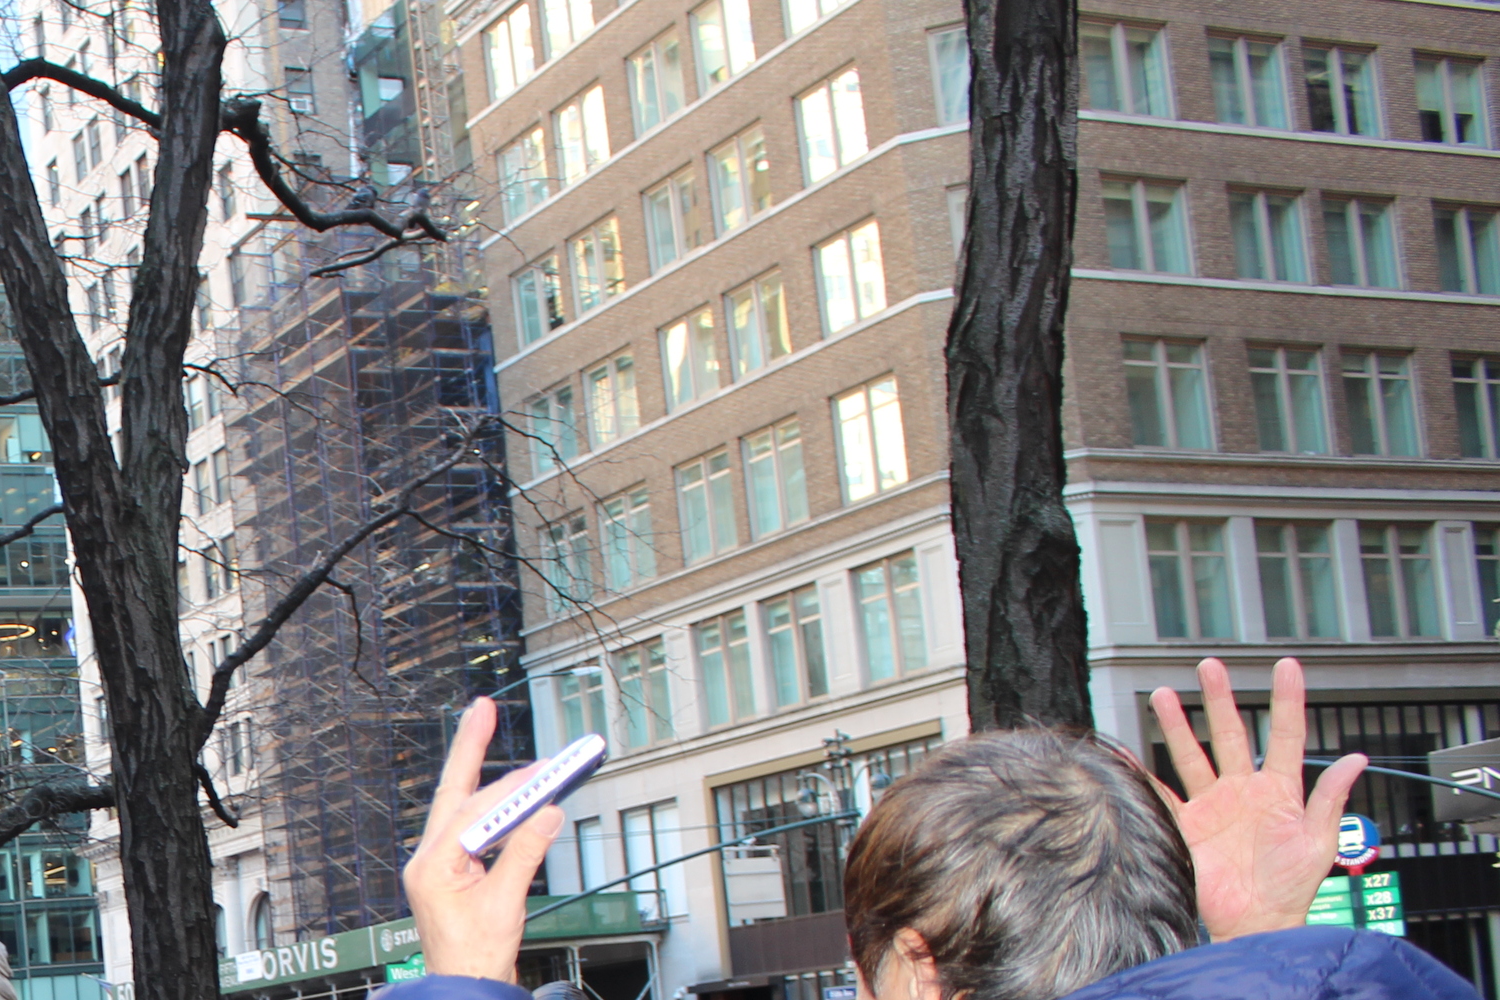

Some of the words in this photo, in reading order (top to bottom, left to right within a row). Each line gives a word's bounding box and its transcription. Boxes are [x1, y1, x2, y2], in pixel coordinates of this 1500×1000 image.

[1341, 847, 1376, 866] STANDING
[262, 937, 338, 981] ORVIS
[390, 967, 419, 980] West
